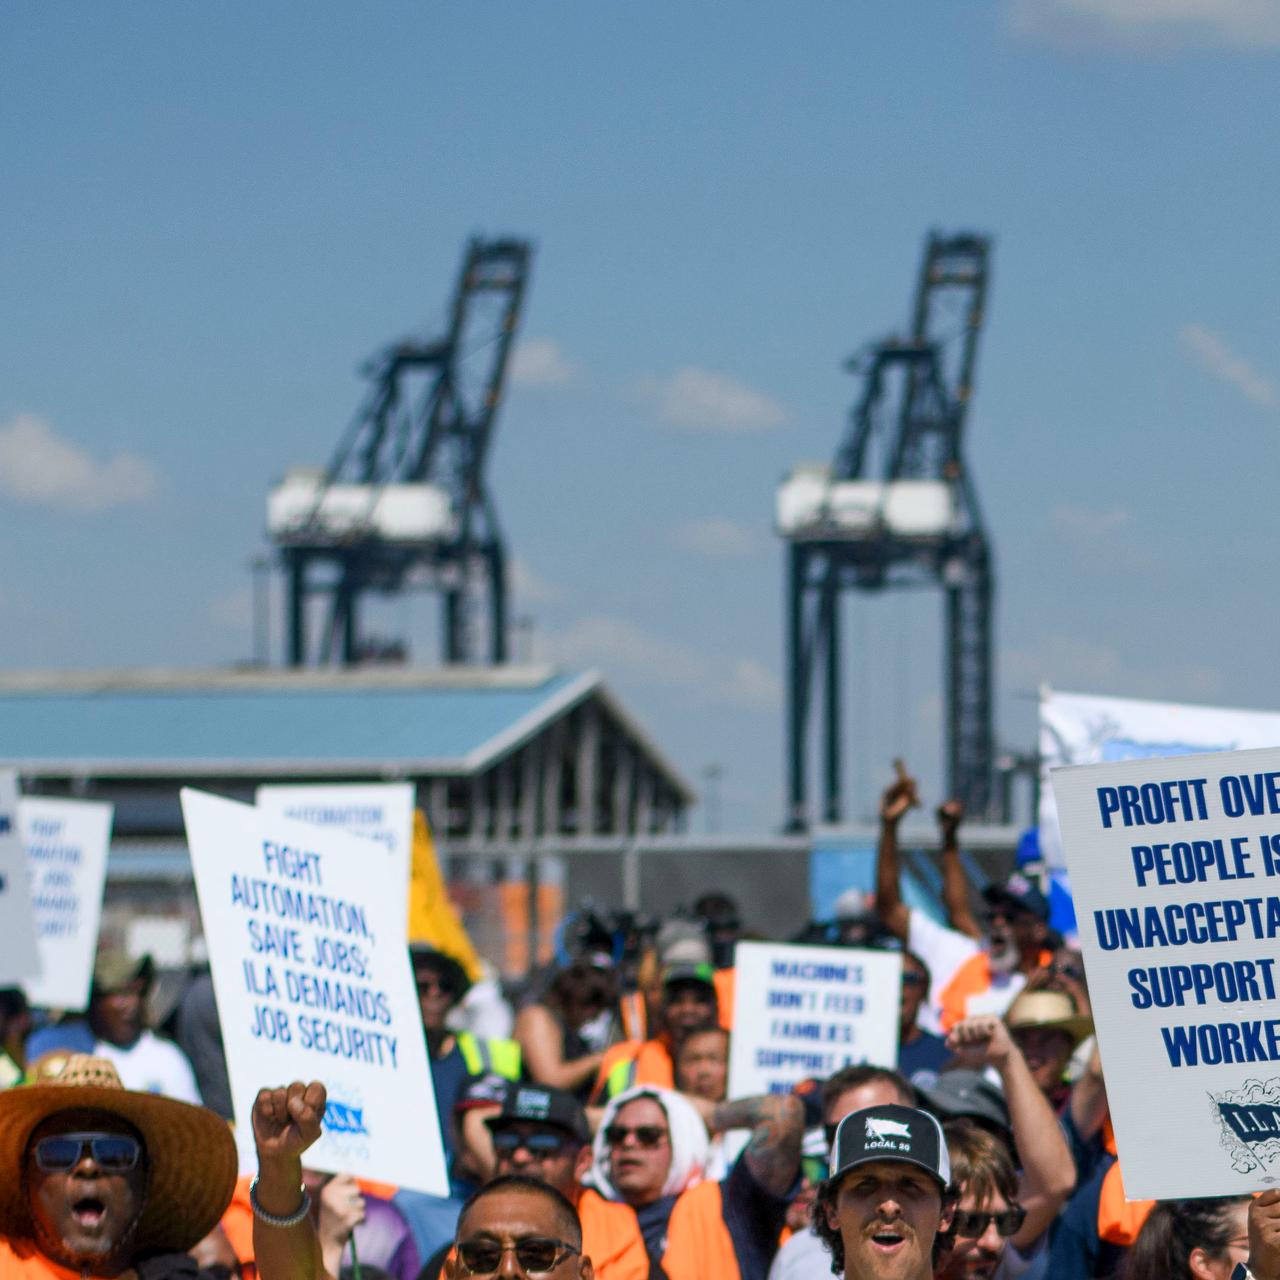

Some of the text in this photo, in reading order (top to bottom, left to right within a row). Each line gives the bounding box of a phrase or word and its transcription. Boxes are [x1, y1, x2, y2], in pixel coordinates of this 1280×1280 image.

[1097, 777, 1208, 829] PROFIT
[262, 840, 322, 887] FIGHT
[1131, 836, 1255, 887] PEOPLE
[231, 874, 375, 946] AUTOMATION,
[247, 919, 372, 980] SAVE JOBS:
[771, 961, 863, 984] MACHINES
[242, 959, 393, 1026] ILA DEMANDS
[823, 990, 864, 1014] FEED
[1128, 957, 1280, 1010] SUPPORT
[251, 1005, 398, 1070] JOB SECURITY
[755, 1047, 834, 1070] SUPPORT
[864, 1141, 897, 1151] LOCAL
